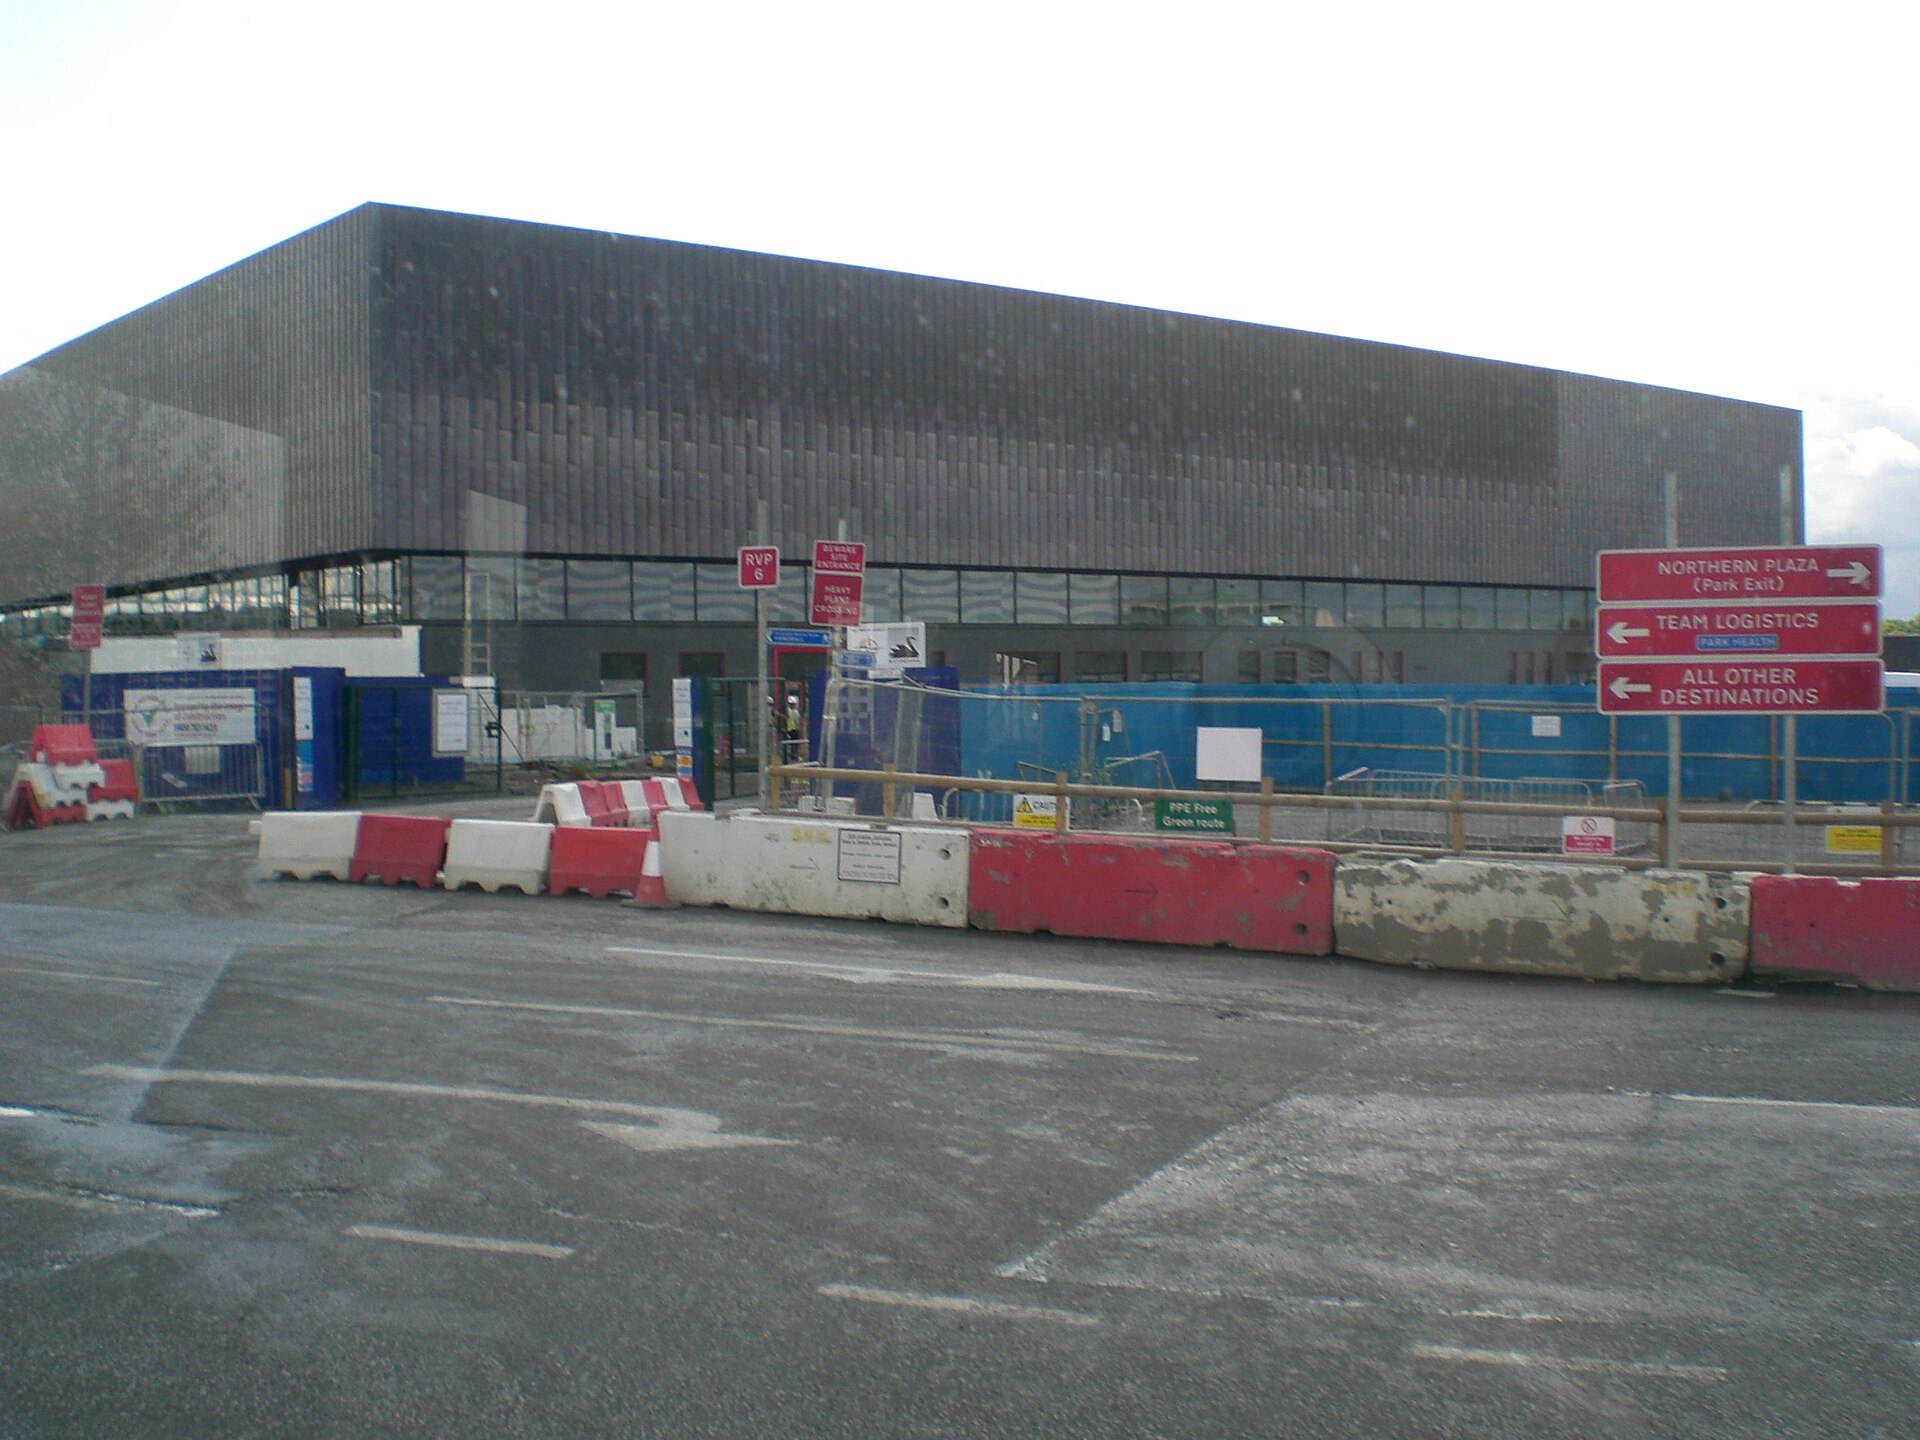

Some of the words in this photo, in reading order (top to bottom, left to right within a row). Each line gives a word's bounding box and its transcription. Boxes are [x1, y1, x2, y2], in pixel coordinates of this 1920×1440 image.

[823, 544, 857, 555] BEWARE
[745, 553, 773, 566] RVP
[816, 561, 860, 571] ENTRANCE
[1657, 559, 1758, 576] NORTHERN
[1765, 558, 1819, 573] PLAZA
[754, 568, 764, 581] 6
[824, 585, 851, 595] HEAVY
[1693, 577, 1739, 593] (Park
[1744, 576, 1785, 592] Exit)
[824, 595, 850, 605] PLANT
[814, 604, 858, 616] CROSSING
[1656, 614, 1709, 630] TEAM
[1715, 612, 1819, 630] LOGISTICS
[1700, 636, 1728, 648] PARK
[1732, 635, 1778, 648] HEALTH
[1681, 669, 1718, 685] ALL
[1724, 668, 1797, 684] OTHER
[1660, 688, 1819, 706] DESTINATIONS
[1169, 802, 1191, 814] PPE
[1193, 802, 1218, 815] Free
[1162, 816, 1195, 827] Green
[1196, 818, 1225, 829] route
